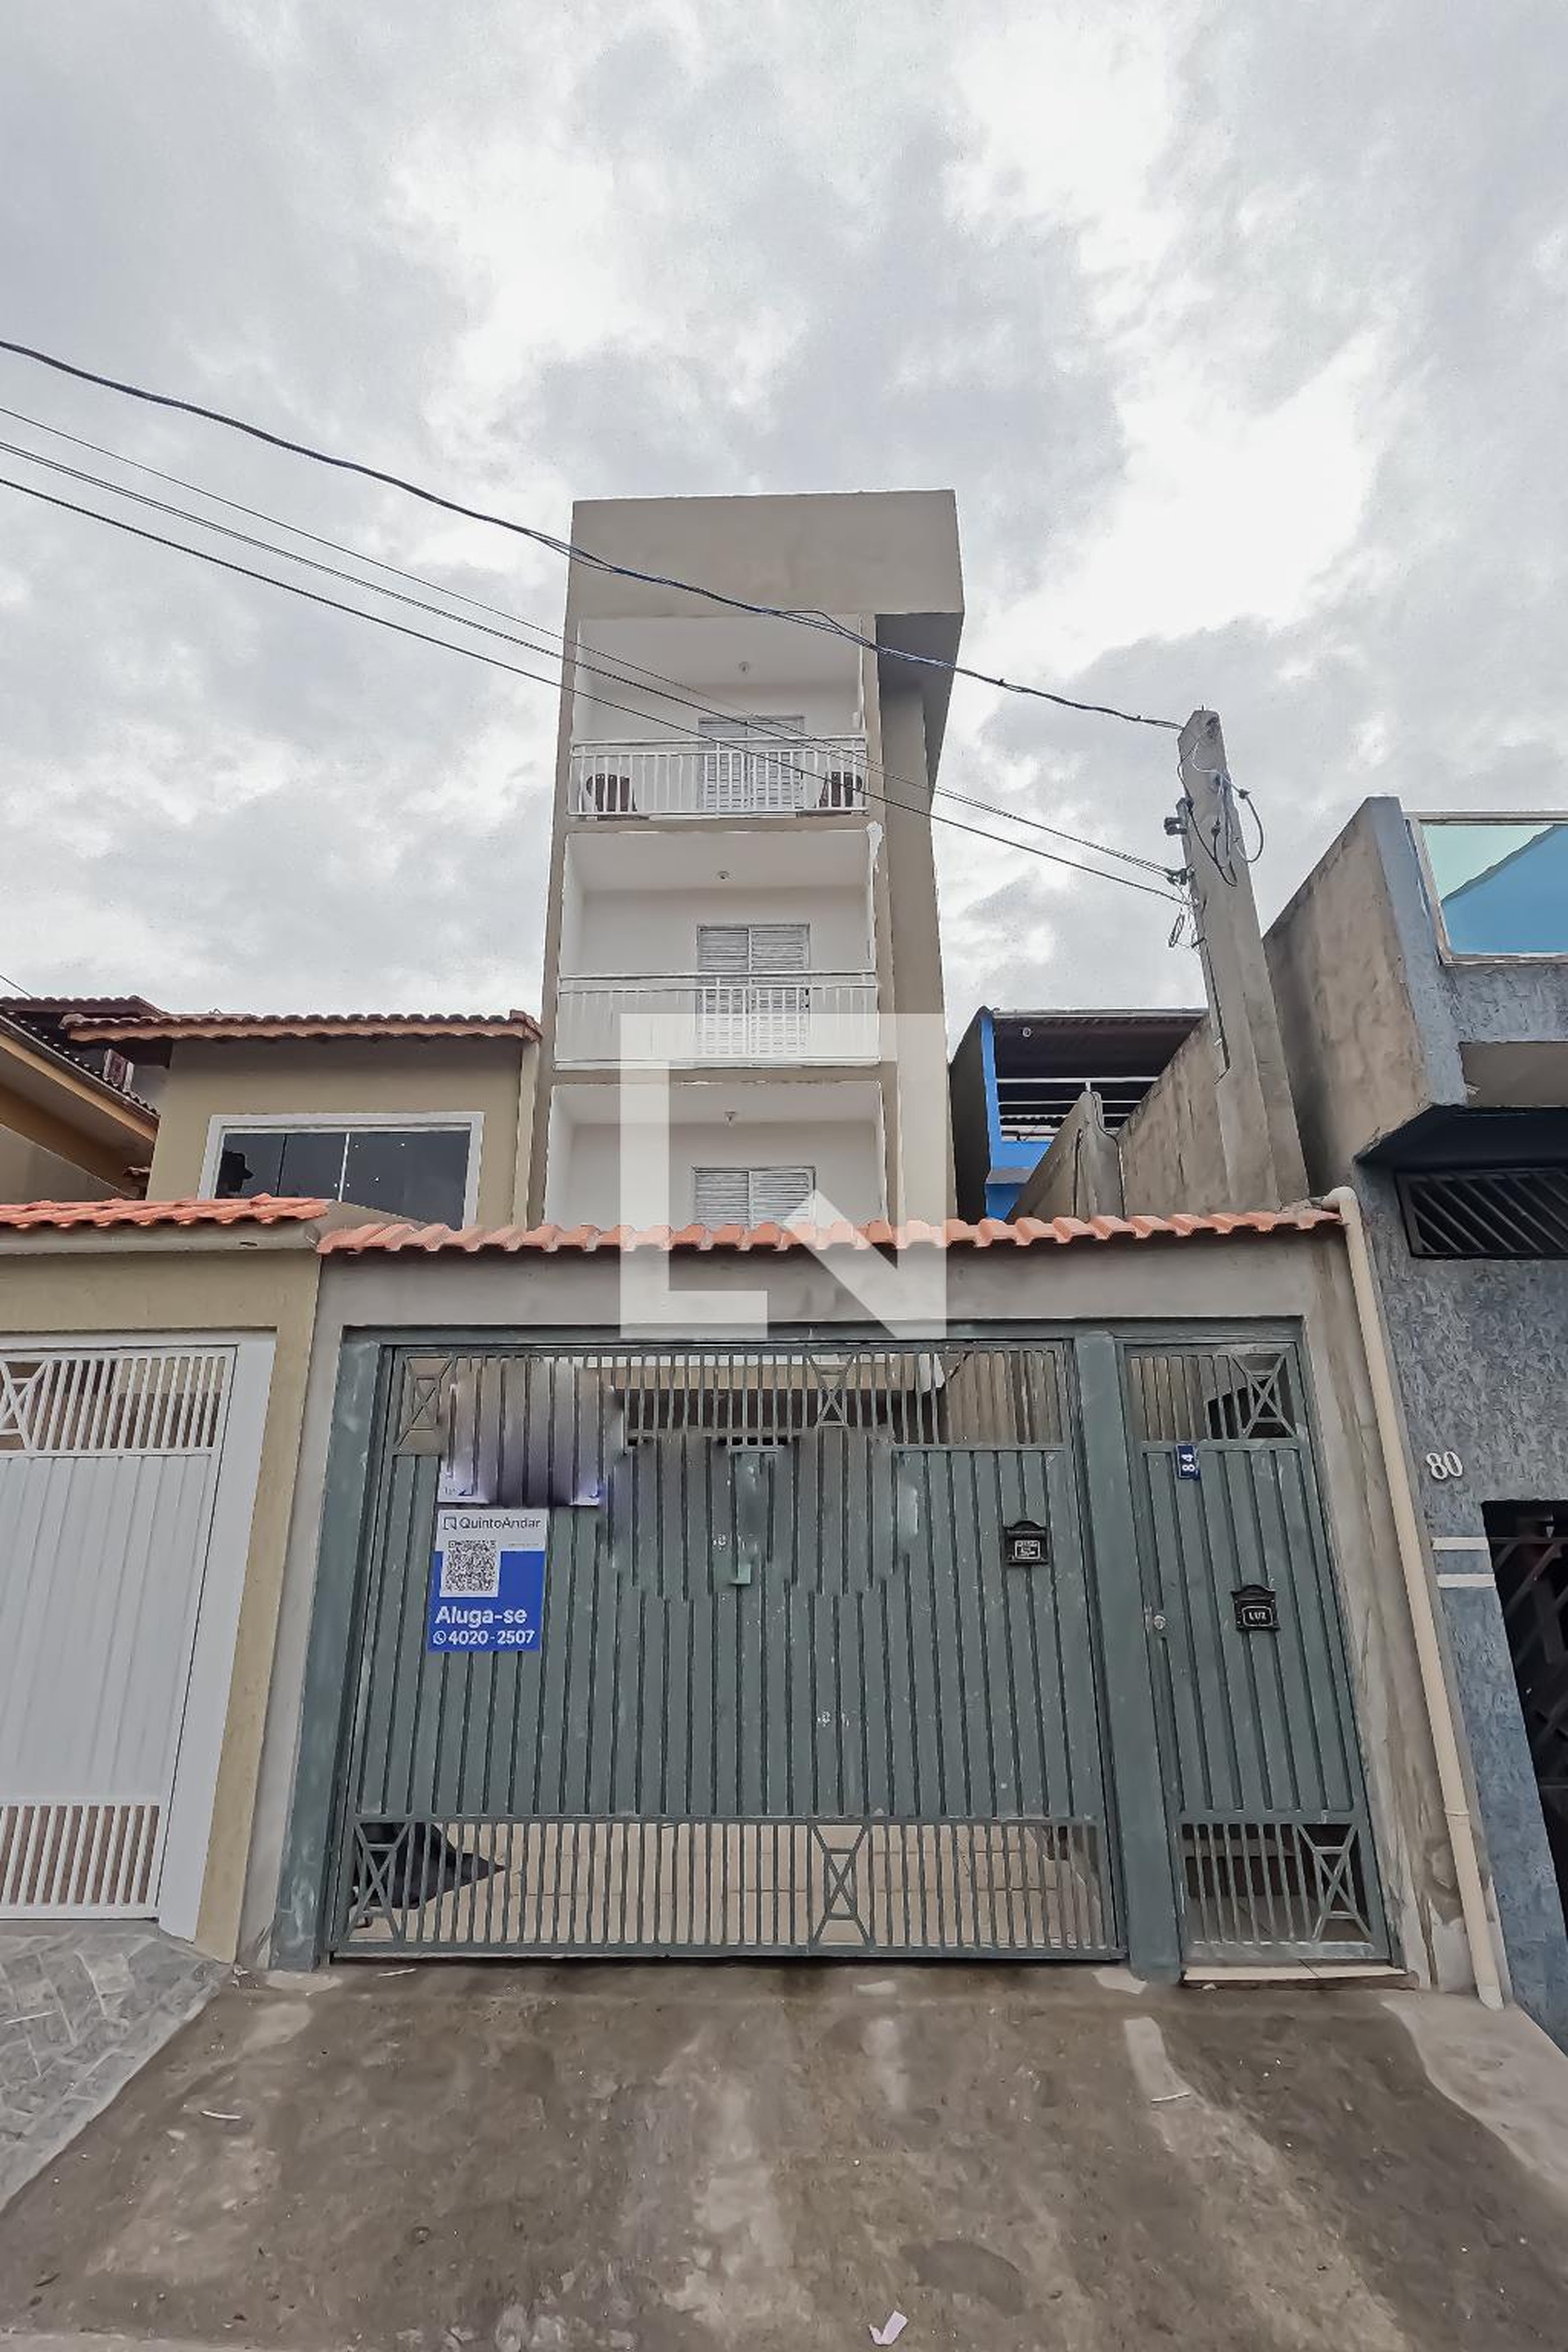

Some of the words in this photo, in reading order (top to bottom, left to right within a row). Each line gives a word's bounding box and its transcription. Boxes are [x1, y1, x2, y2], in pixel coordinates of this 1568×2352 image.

[1181, 1454, 1196, 1472] 84
[1426, 1451, 1463, 1480] 80
[459, 1517, 541, 1529] QuintoAndar
[434, 1606, 528, 1628] Aluga-se
[1249, 1612, 1267, 1621] LUZ
